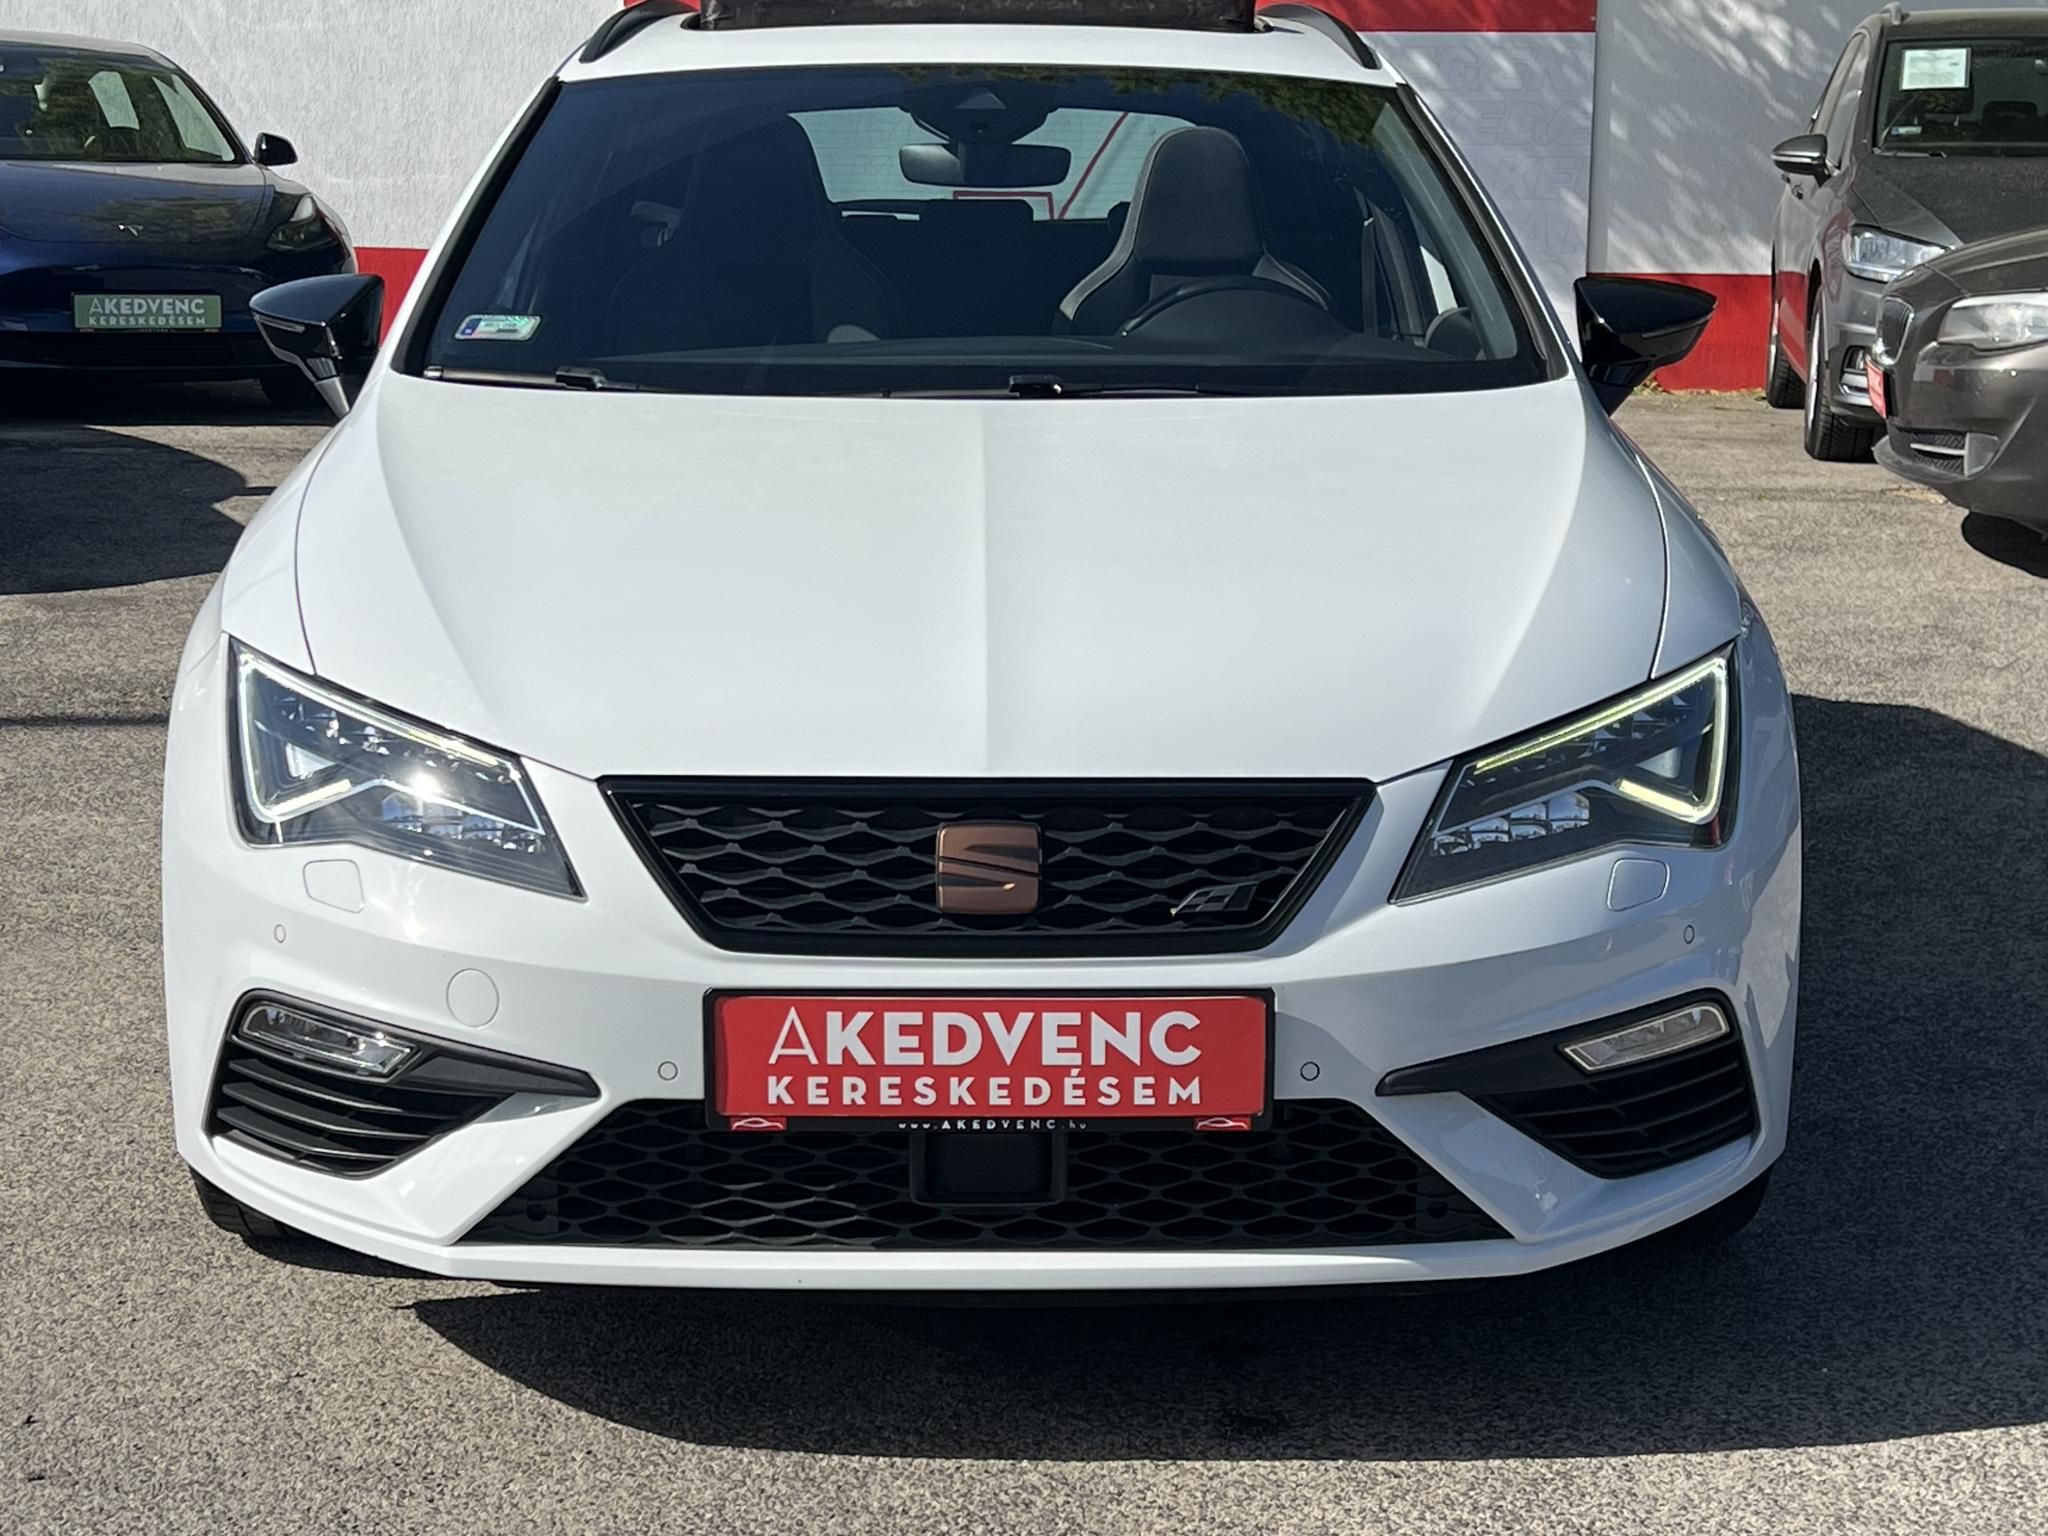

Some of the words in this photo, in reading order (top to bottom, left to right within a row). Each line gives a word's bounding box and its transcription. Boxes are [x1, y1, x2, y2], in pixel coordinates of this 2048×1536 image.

[88, 314, 206, 326] KERESKEDÉSEM
[89, 297, 206, 315] AKEDVENC
[768, 1006, 1202, 1066] AKEDVENC
[768, 1068, 1201, 1106] KERESKEDÉSEM
